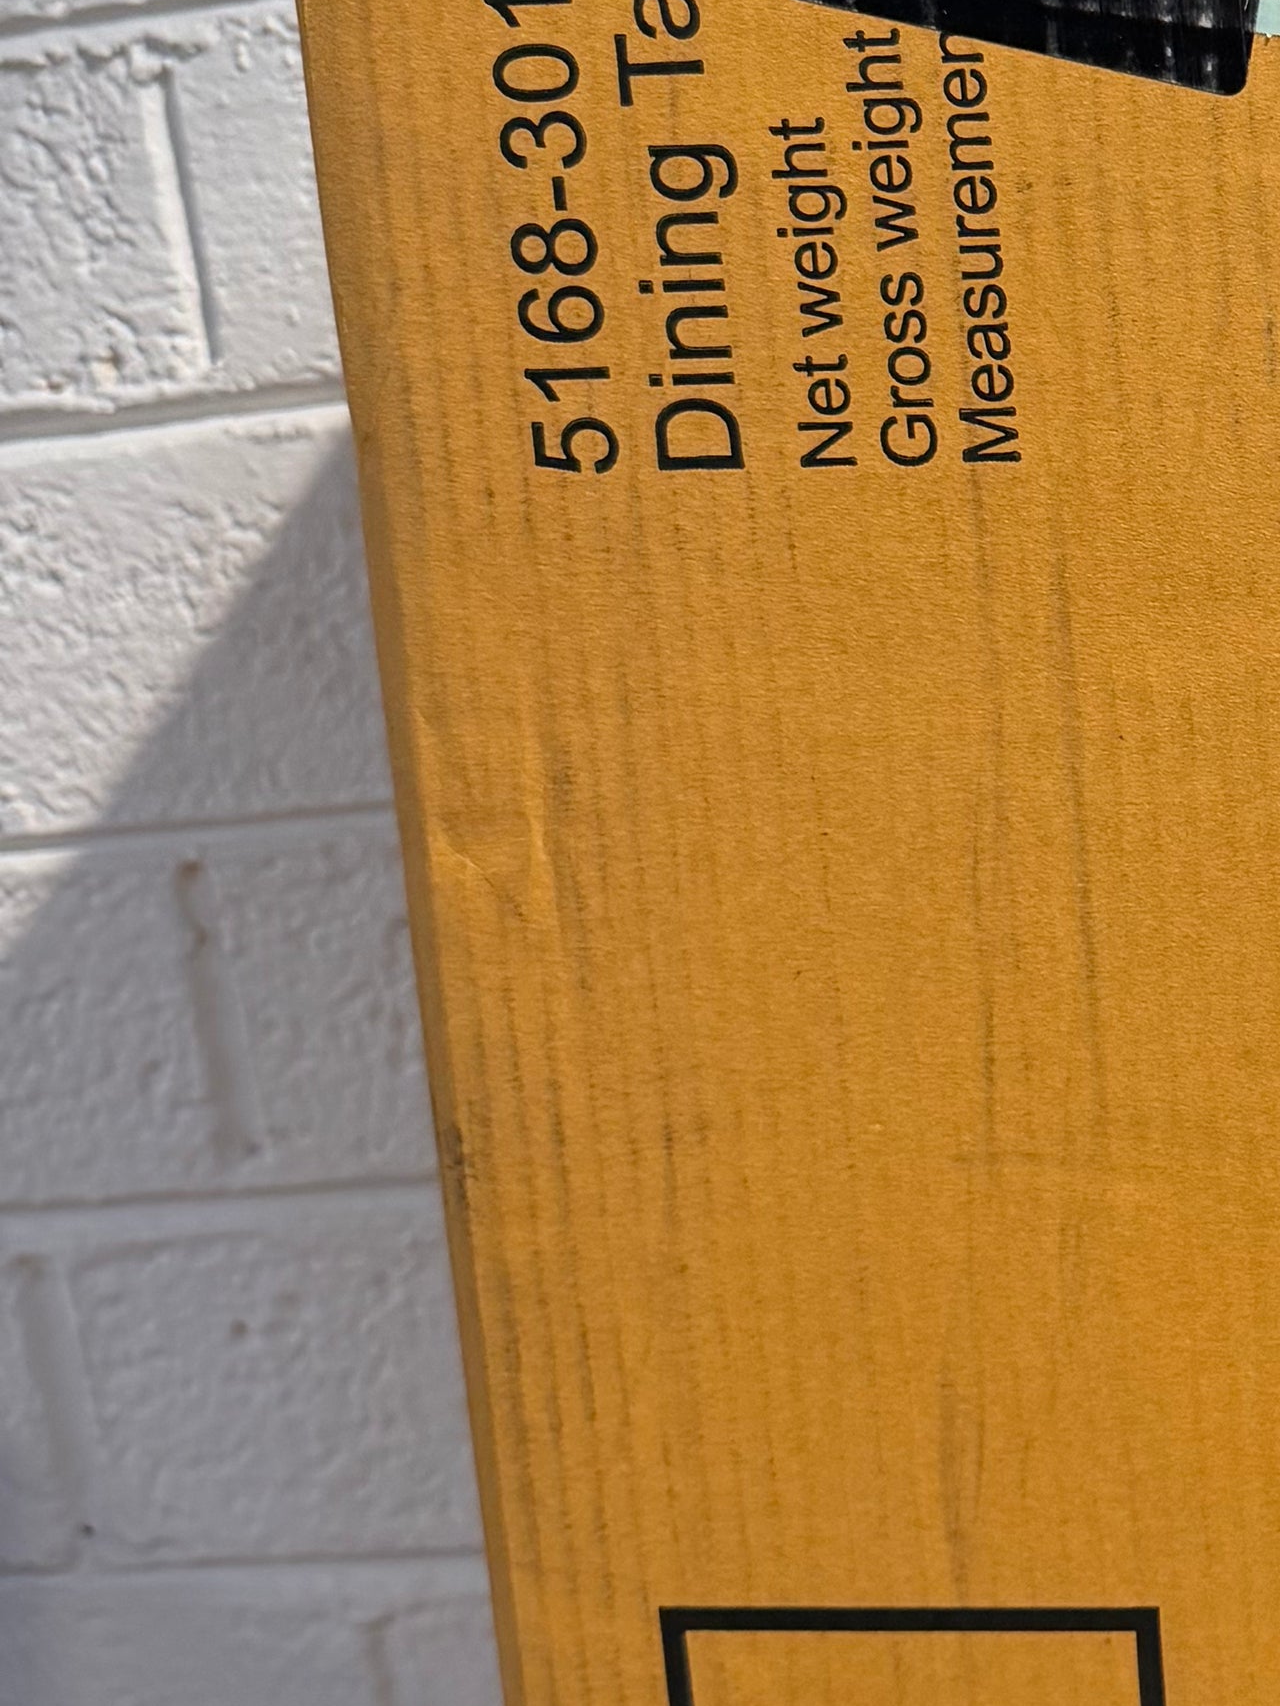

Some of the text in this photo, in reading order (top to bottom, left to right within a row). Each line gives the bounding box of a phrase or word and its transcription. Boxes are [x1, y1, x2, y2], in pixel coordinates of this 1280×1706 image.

[768, 117, 845, 337] weight
[843, 28, 922, 252] weight
[938, 32, 1021, 463] Measuremen
[638, 144, 745, 471] Dining
[793, 354, 858, 468] Net
[880, 272, 937, 466] Gross
